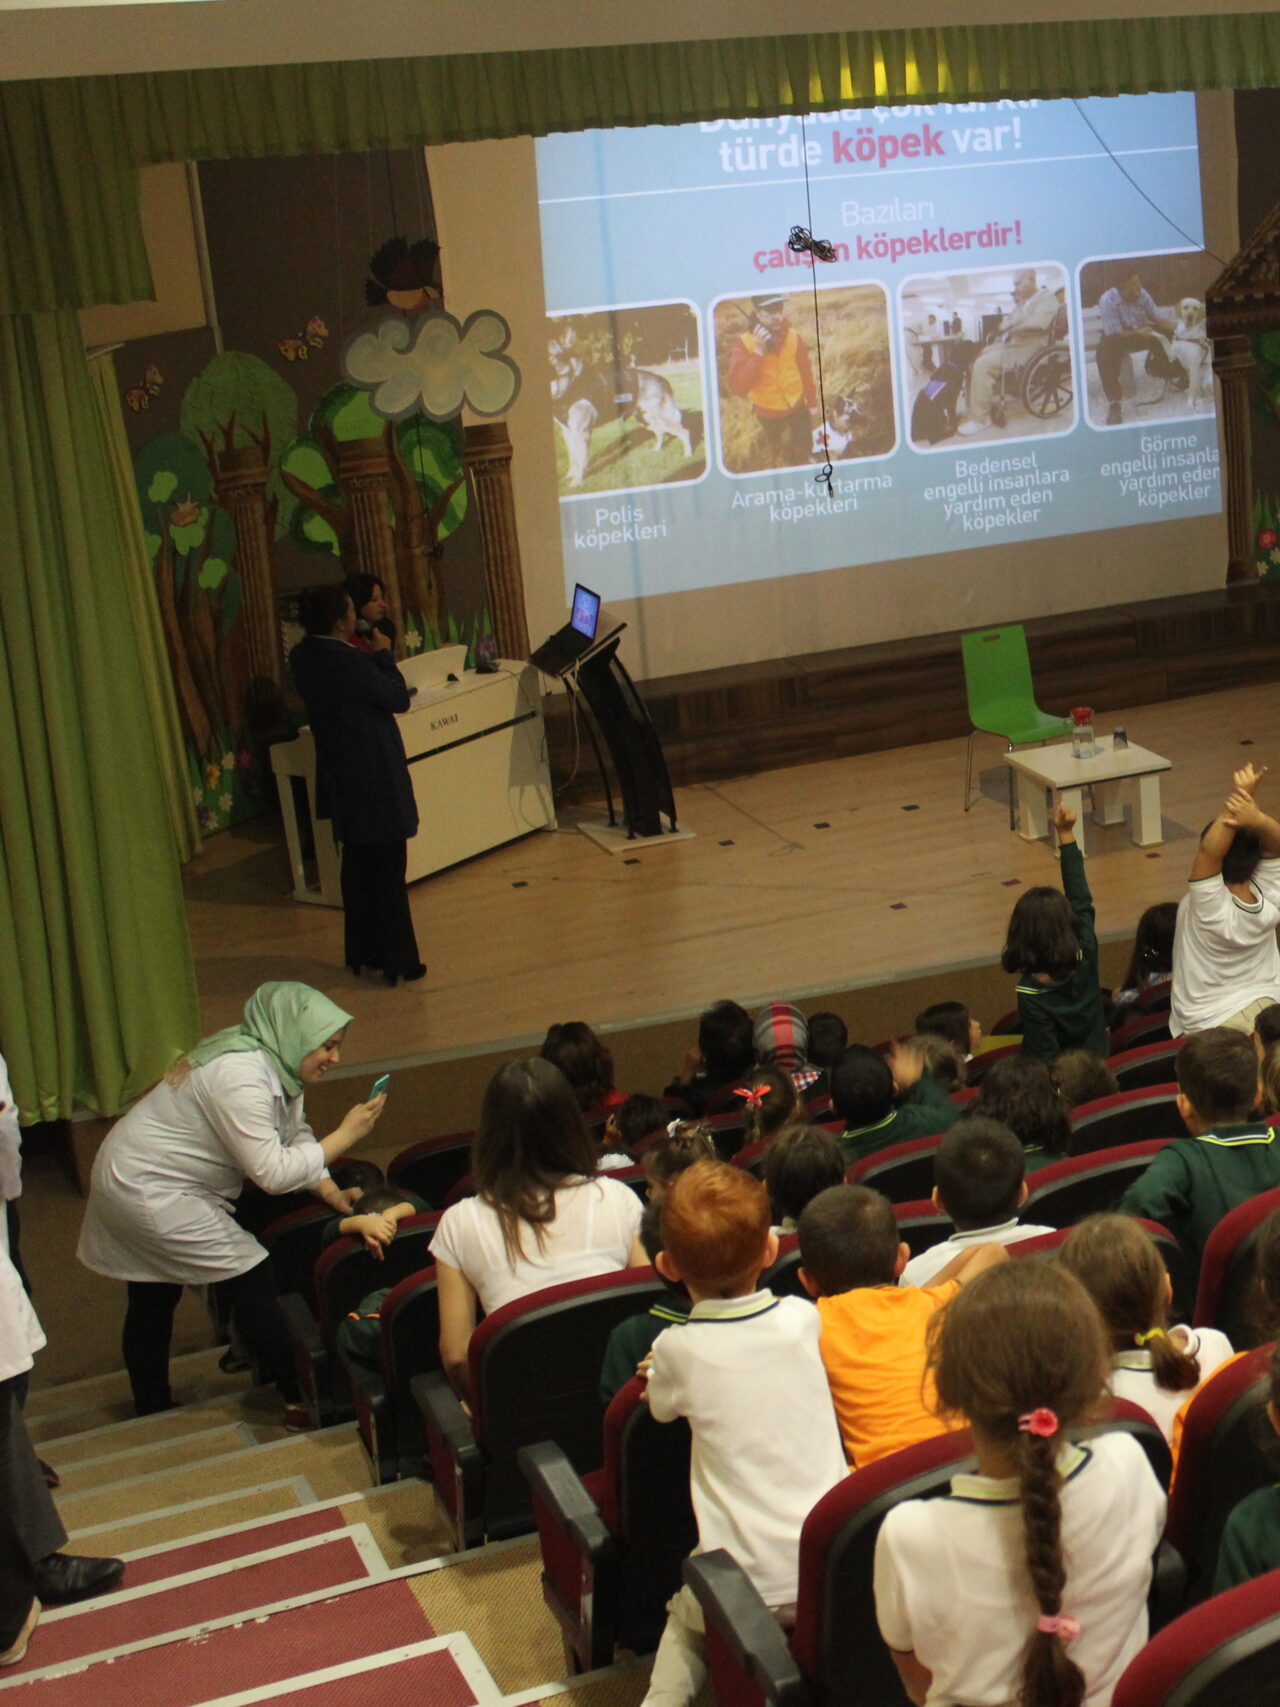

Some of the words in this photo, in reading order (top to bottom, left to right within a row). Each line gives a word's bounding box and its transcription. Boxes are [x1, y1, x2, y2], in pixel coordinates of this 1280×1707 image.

[719, 134, 823, 172] türde
[832, 123, 945, 168] köpek
[952, 116, 1022, 154] var!
[842, 198, 935, 227] Bazıları
[856, 220, 1022, 262] köpeklerdir!
[1141, 434, 1197, 454] Görme
[955, 451, 1037, 478] Bedensel
[1101, 452, 1158, 476] engelli
[924, 476, 984, 500] engelli
[987, 468, 1069, 490] insanlara
[1119, 470, 1177, 495] yardım
[1138, 483, 1211, 509] köpekler
[595, 506, 644, 527] Polis
[770, 493, 858, 523] köpekleri
[944, 495, 1006, 520] yardım
[1010, 488, 1053, 506] eden
[963, 507, 1041, 533] köpekler
[574, 520, 667, 550] köpekleri
[430, 713, 458, 731] KAWAI
